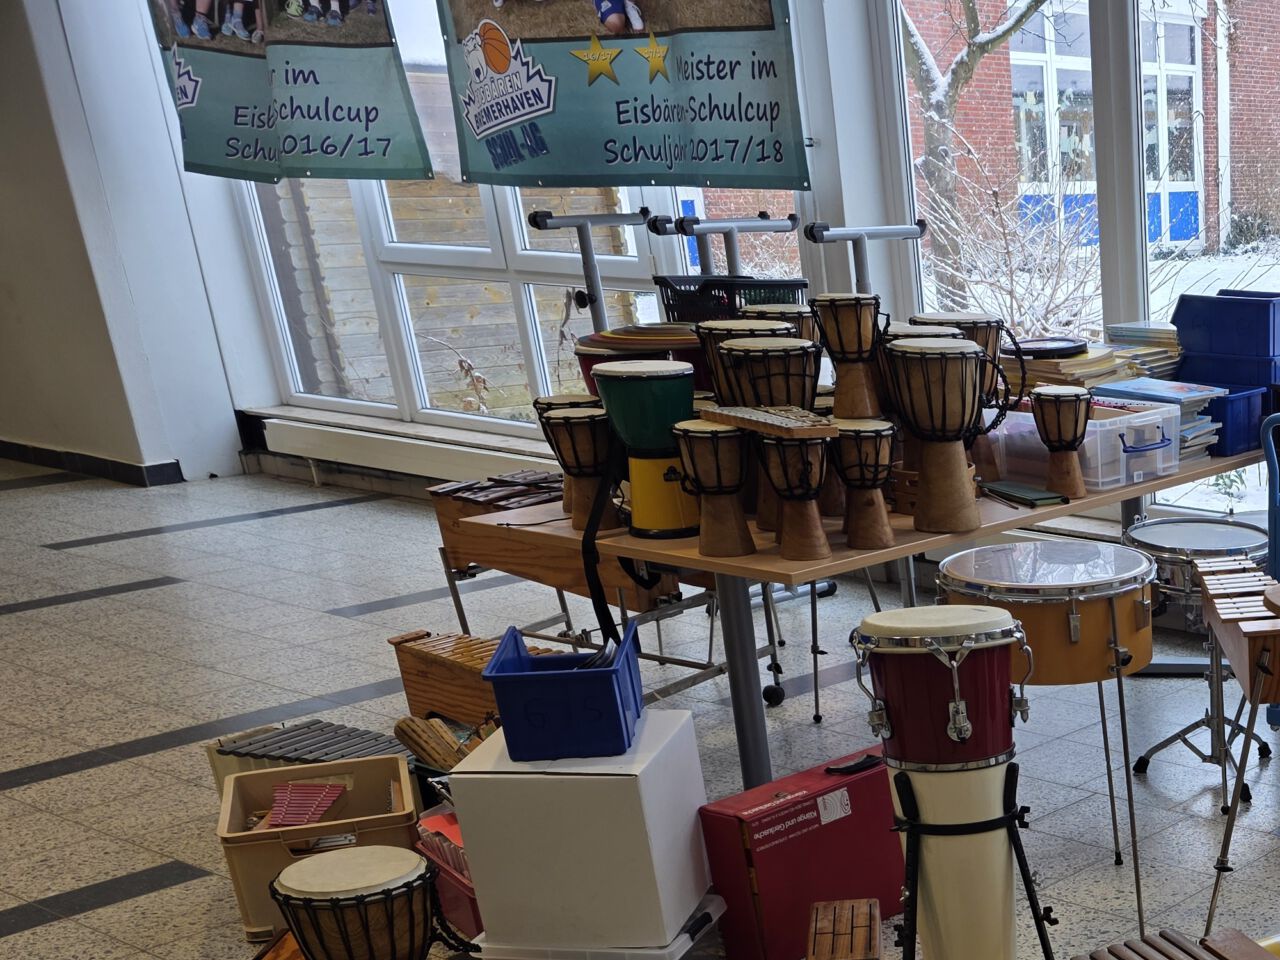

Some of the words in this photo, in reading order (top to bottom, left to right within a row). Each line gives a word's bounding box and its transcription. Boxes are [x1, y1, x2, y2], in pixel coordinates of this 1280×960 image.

[283, 60, 320, 85] im
[751, 50, 778, 80] im
[474, 87, 545, 130] BREMERHAVEN
[615, 91, 780, 132] Eisbären-Schulcup
[689, 135, 784, 164] 2017/18
